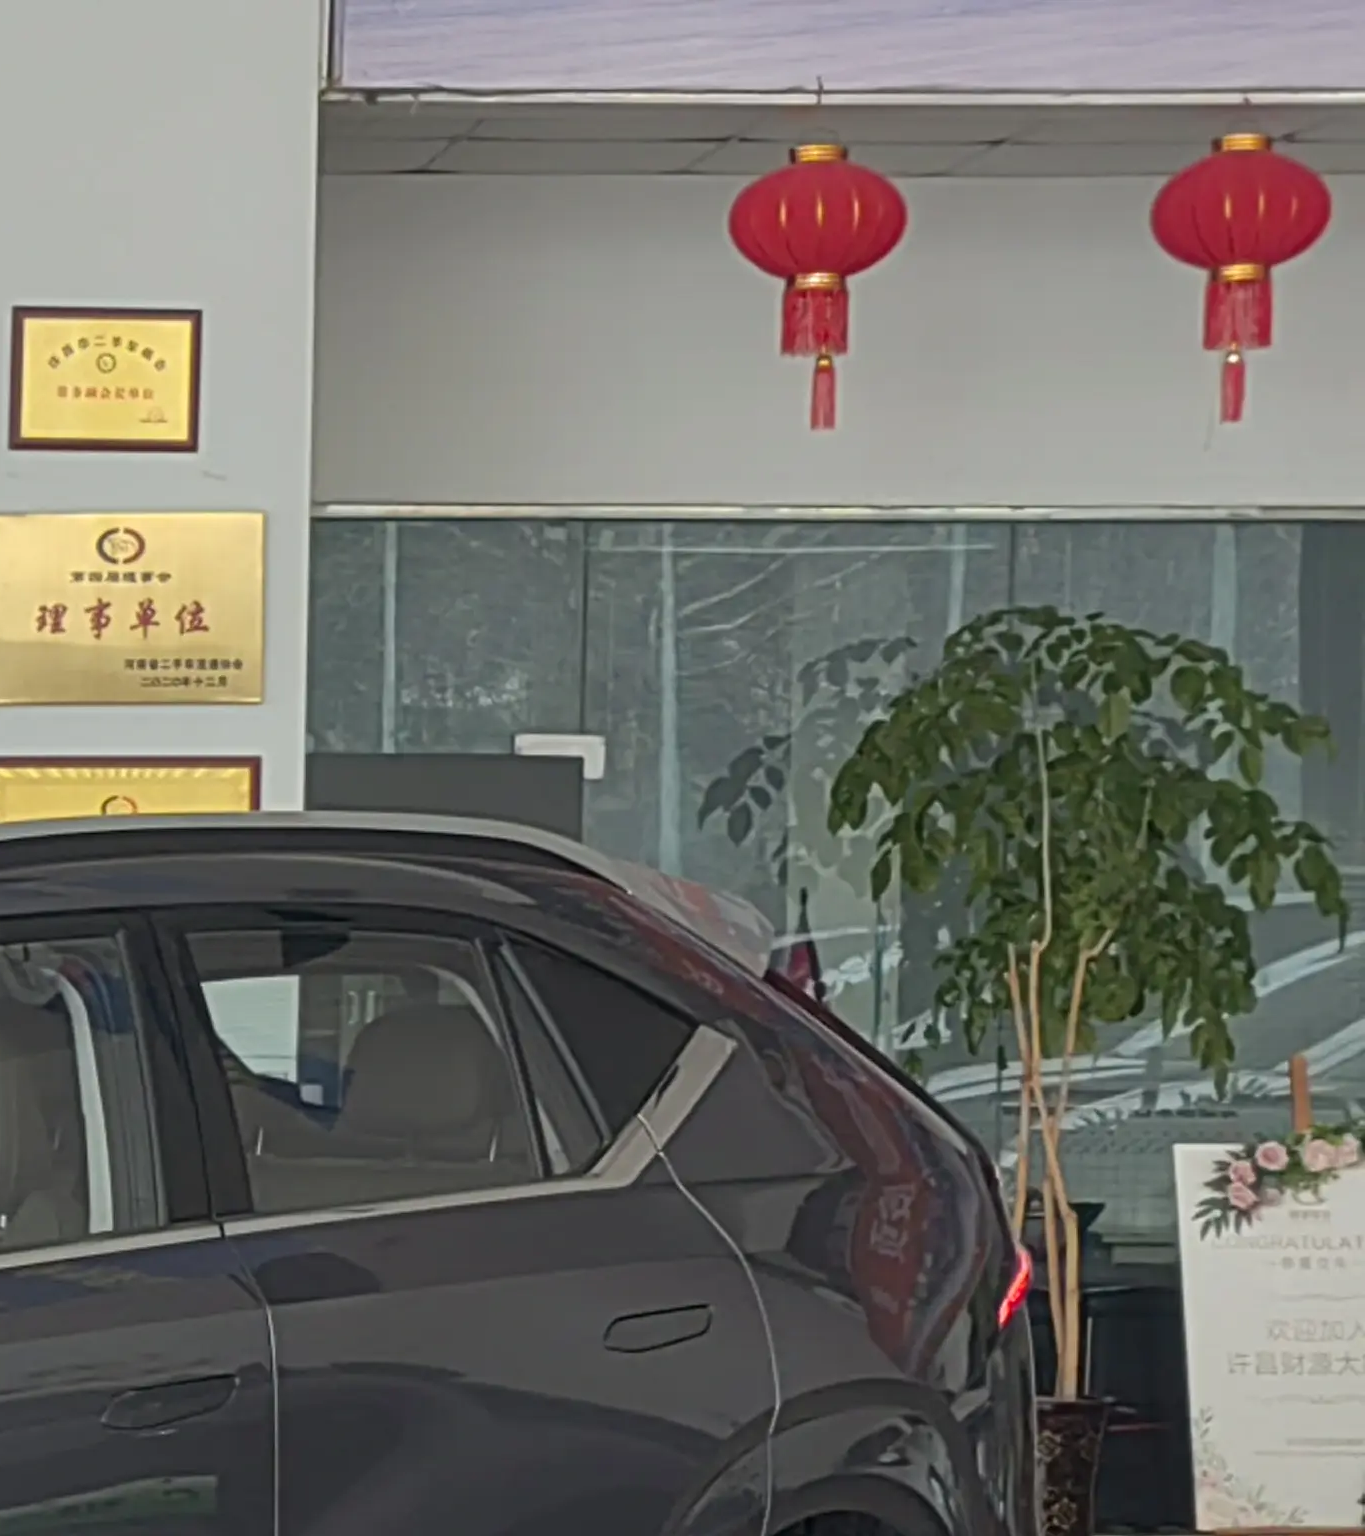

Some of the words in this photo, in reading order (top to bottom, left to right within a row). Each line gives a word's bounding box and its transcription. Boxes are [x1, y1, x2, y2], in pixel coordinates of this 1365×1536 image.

[35, 597, 210, 640] 理事单位
[1227, 1351, 1365, 1376] 许昌财源大
